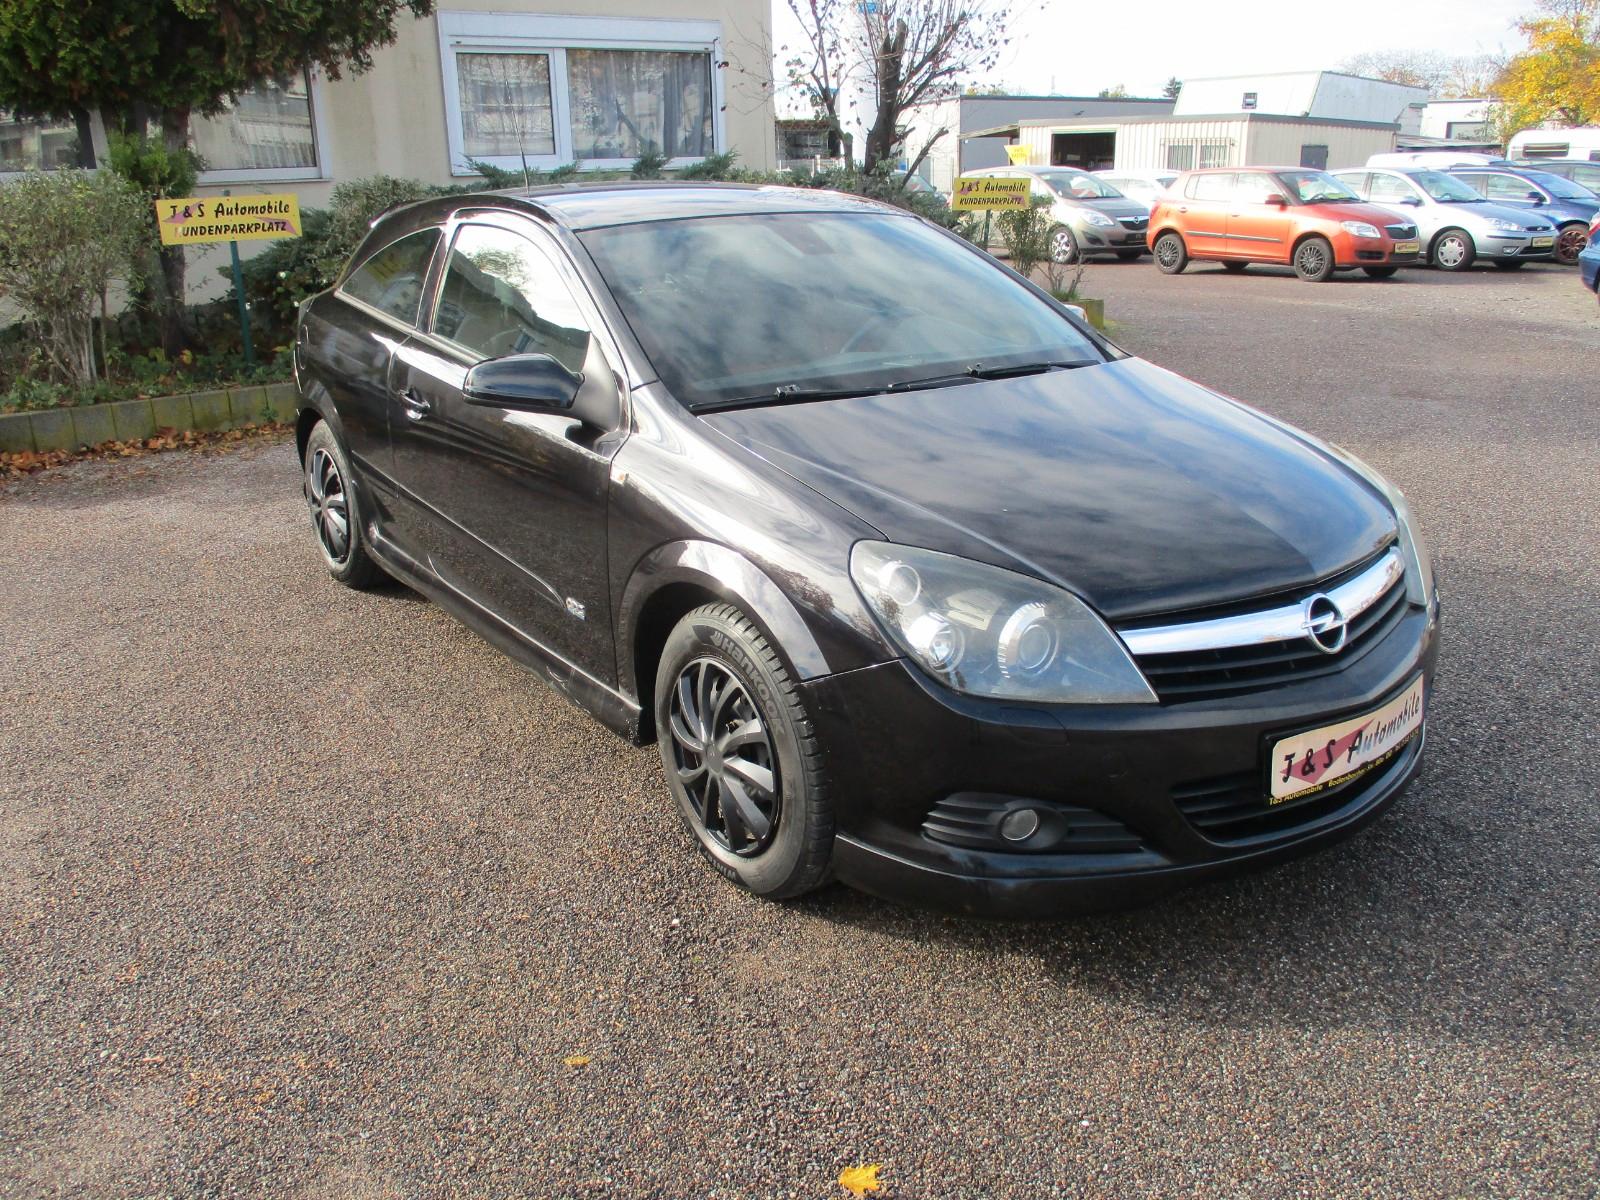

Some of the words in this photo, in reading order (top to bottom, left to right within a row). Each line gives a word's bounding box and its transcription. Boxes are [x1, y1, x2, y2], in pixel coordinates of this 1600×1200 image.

[984, 181, 1026, 193] Automobile
[182, 206, 192, 218] &
[198, 204, 205, 217] S
[214, 200, 290, 218] Automobile
[959, 197, 1022, 206] KUNDENPARKPLATZ
[1301, 748, 1316, 776] &
[1323, 739, 1336, 769] S
[1347, 691, 1420, 764] Automobile
